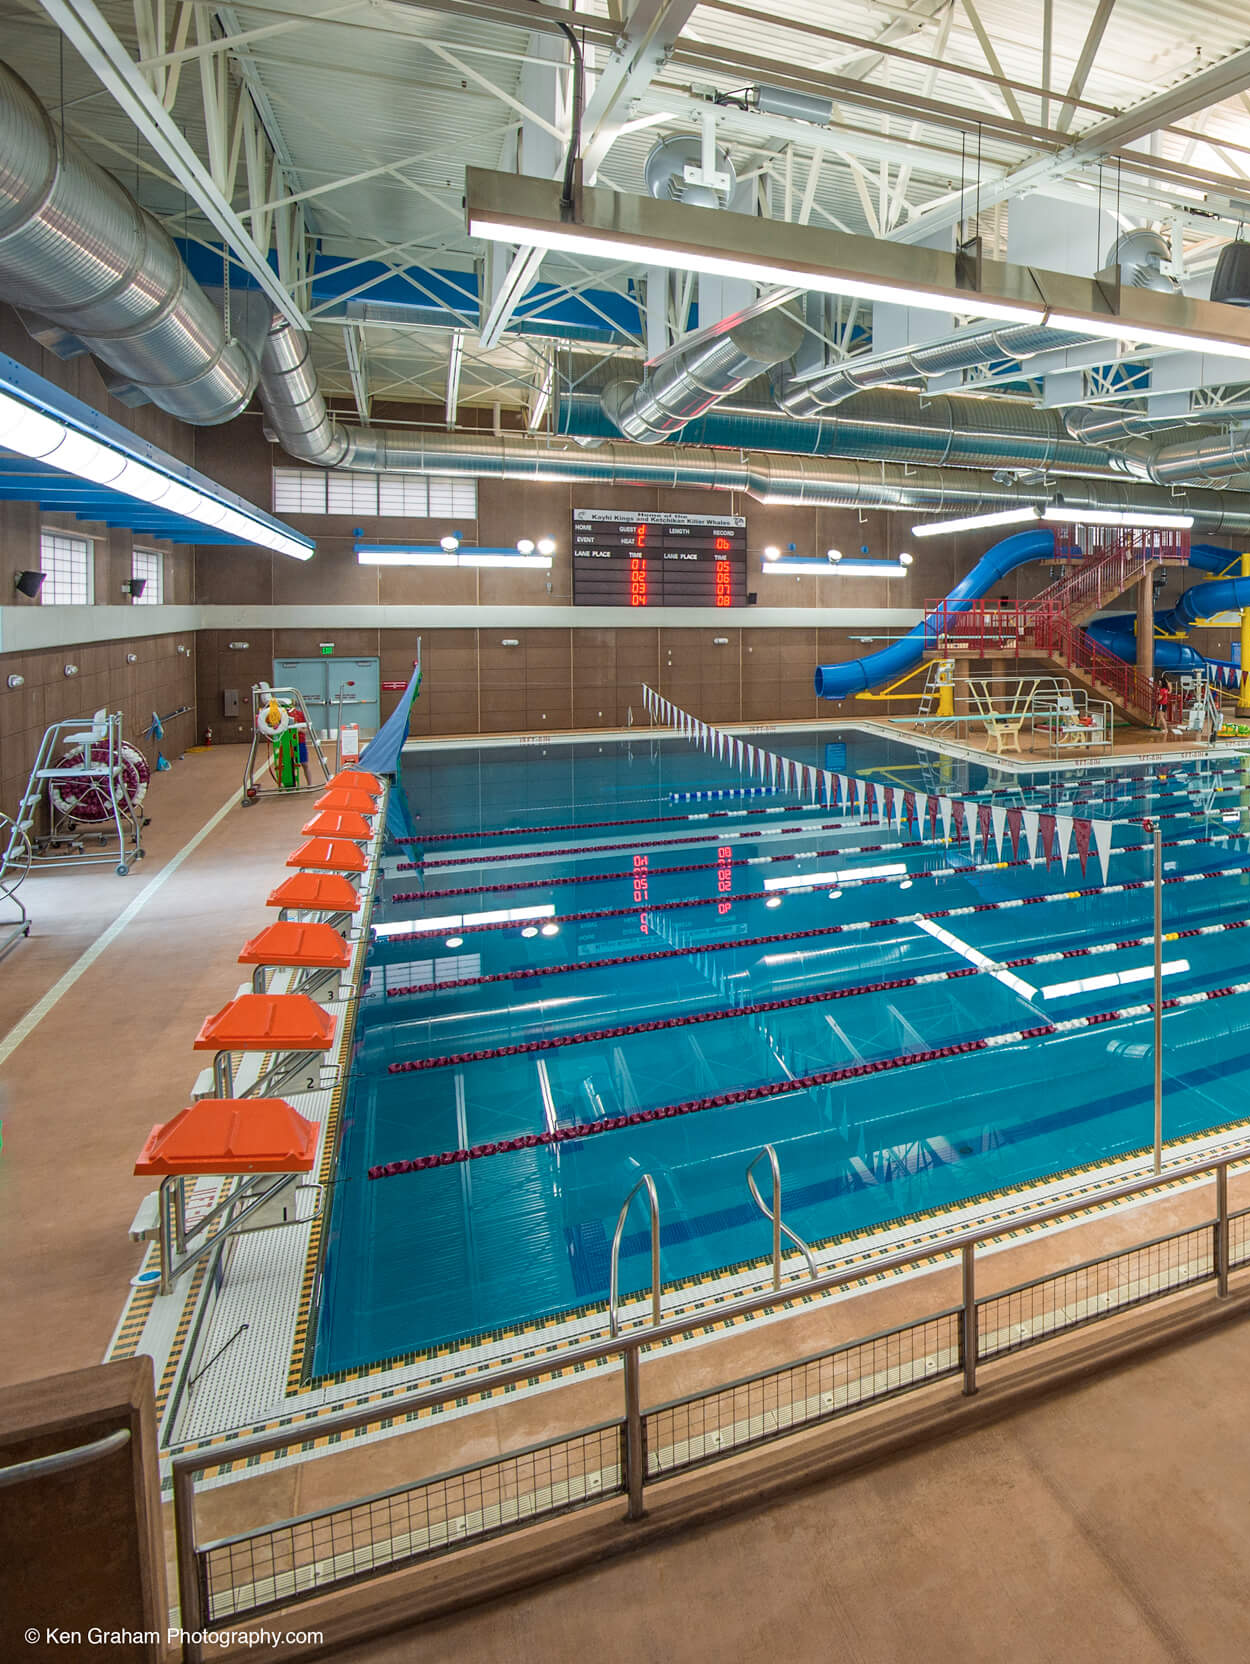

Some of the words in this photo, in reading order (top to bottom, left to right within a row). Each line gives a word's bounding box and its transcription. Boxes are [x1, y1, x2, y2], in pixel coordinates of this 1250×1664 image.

[631, 559, 647, 570] 01
[716, 561, 731, 572] 05
[631, 570, 647, 582] 02
[716, 572, 731, 584] 06
[631, 582, 647, 594] 03
[716, 583, 731, 595] 07
[631, 594, 647, 606] 04
[716, 595, 731, 607] 08
[340, 930, 347, 939] 4
[327, 991, 334, 1000] 3
[306, 1077, 314, 1089] 2
[283, 1207, 288, 1221] 1
